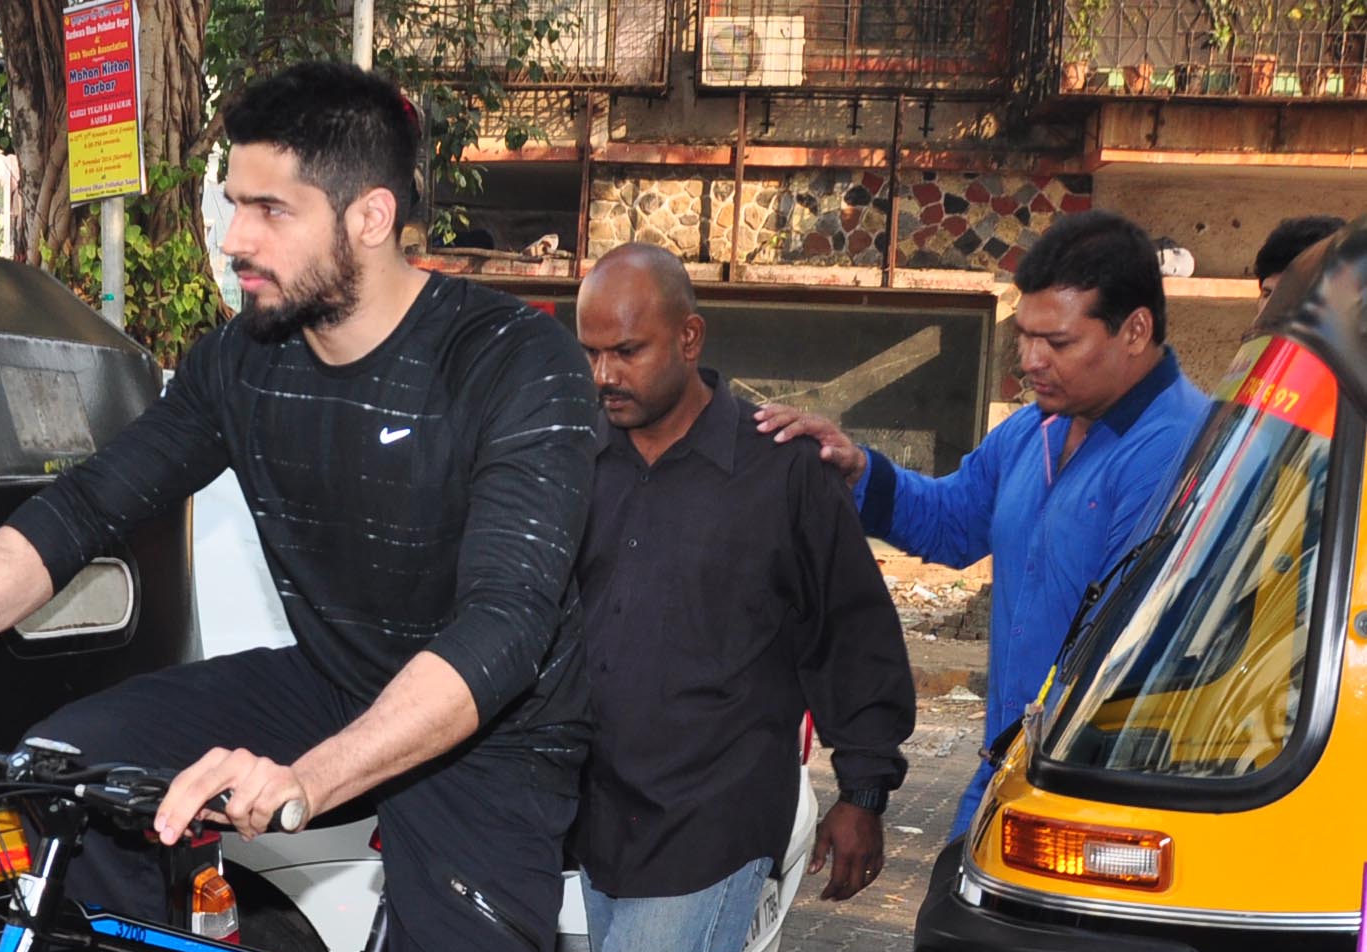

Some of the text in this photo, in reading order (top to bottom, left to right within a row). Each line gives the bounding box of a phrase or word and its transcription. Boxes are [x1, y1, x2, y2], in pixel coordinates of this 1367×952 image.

[97, 41, 129, 55] Association
[101, 61, 131, 76] Kirtan
[83, 80, 116, 96] Darbar
[115, 921, 147, 943] 3700
